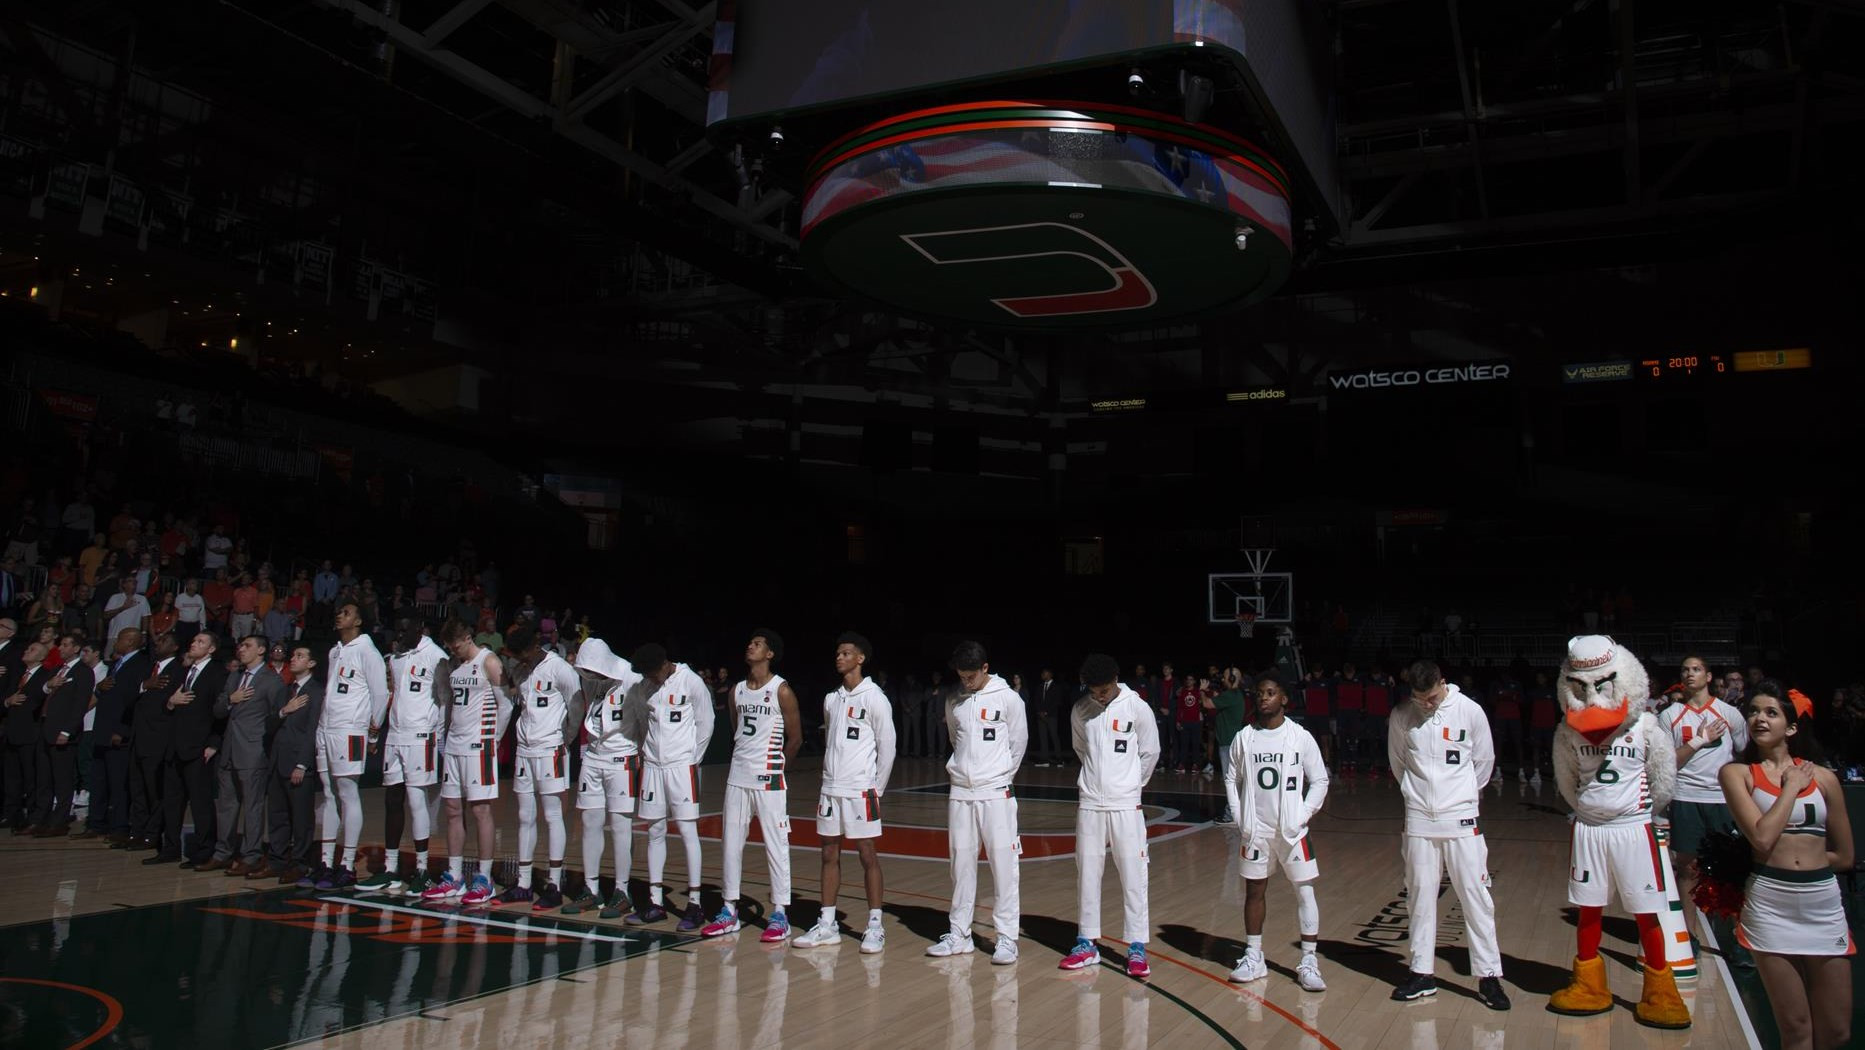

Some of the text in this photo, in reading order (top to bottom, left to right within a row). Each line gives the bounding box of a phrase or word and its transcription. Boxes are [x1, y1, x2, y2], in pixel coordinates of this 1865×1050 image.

[1598, 363, 1631, 371] FORCE
[1669, 357, 1697, 367] 20:00
[1717, 362, 1725, 372] 0
[1653, 366, 1660, 376] 0
[1250, 390, 1286, 400] adidas
[454, 688, 469, 706] 21
[743, 715, 757, 737] 5
[1580, 744, 1636, 758] miami
[1596, 759, 1620, 784] 6
[1257, 766, 1279, 790] 0
